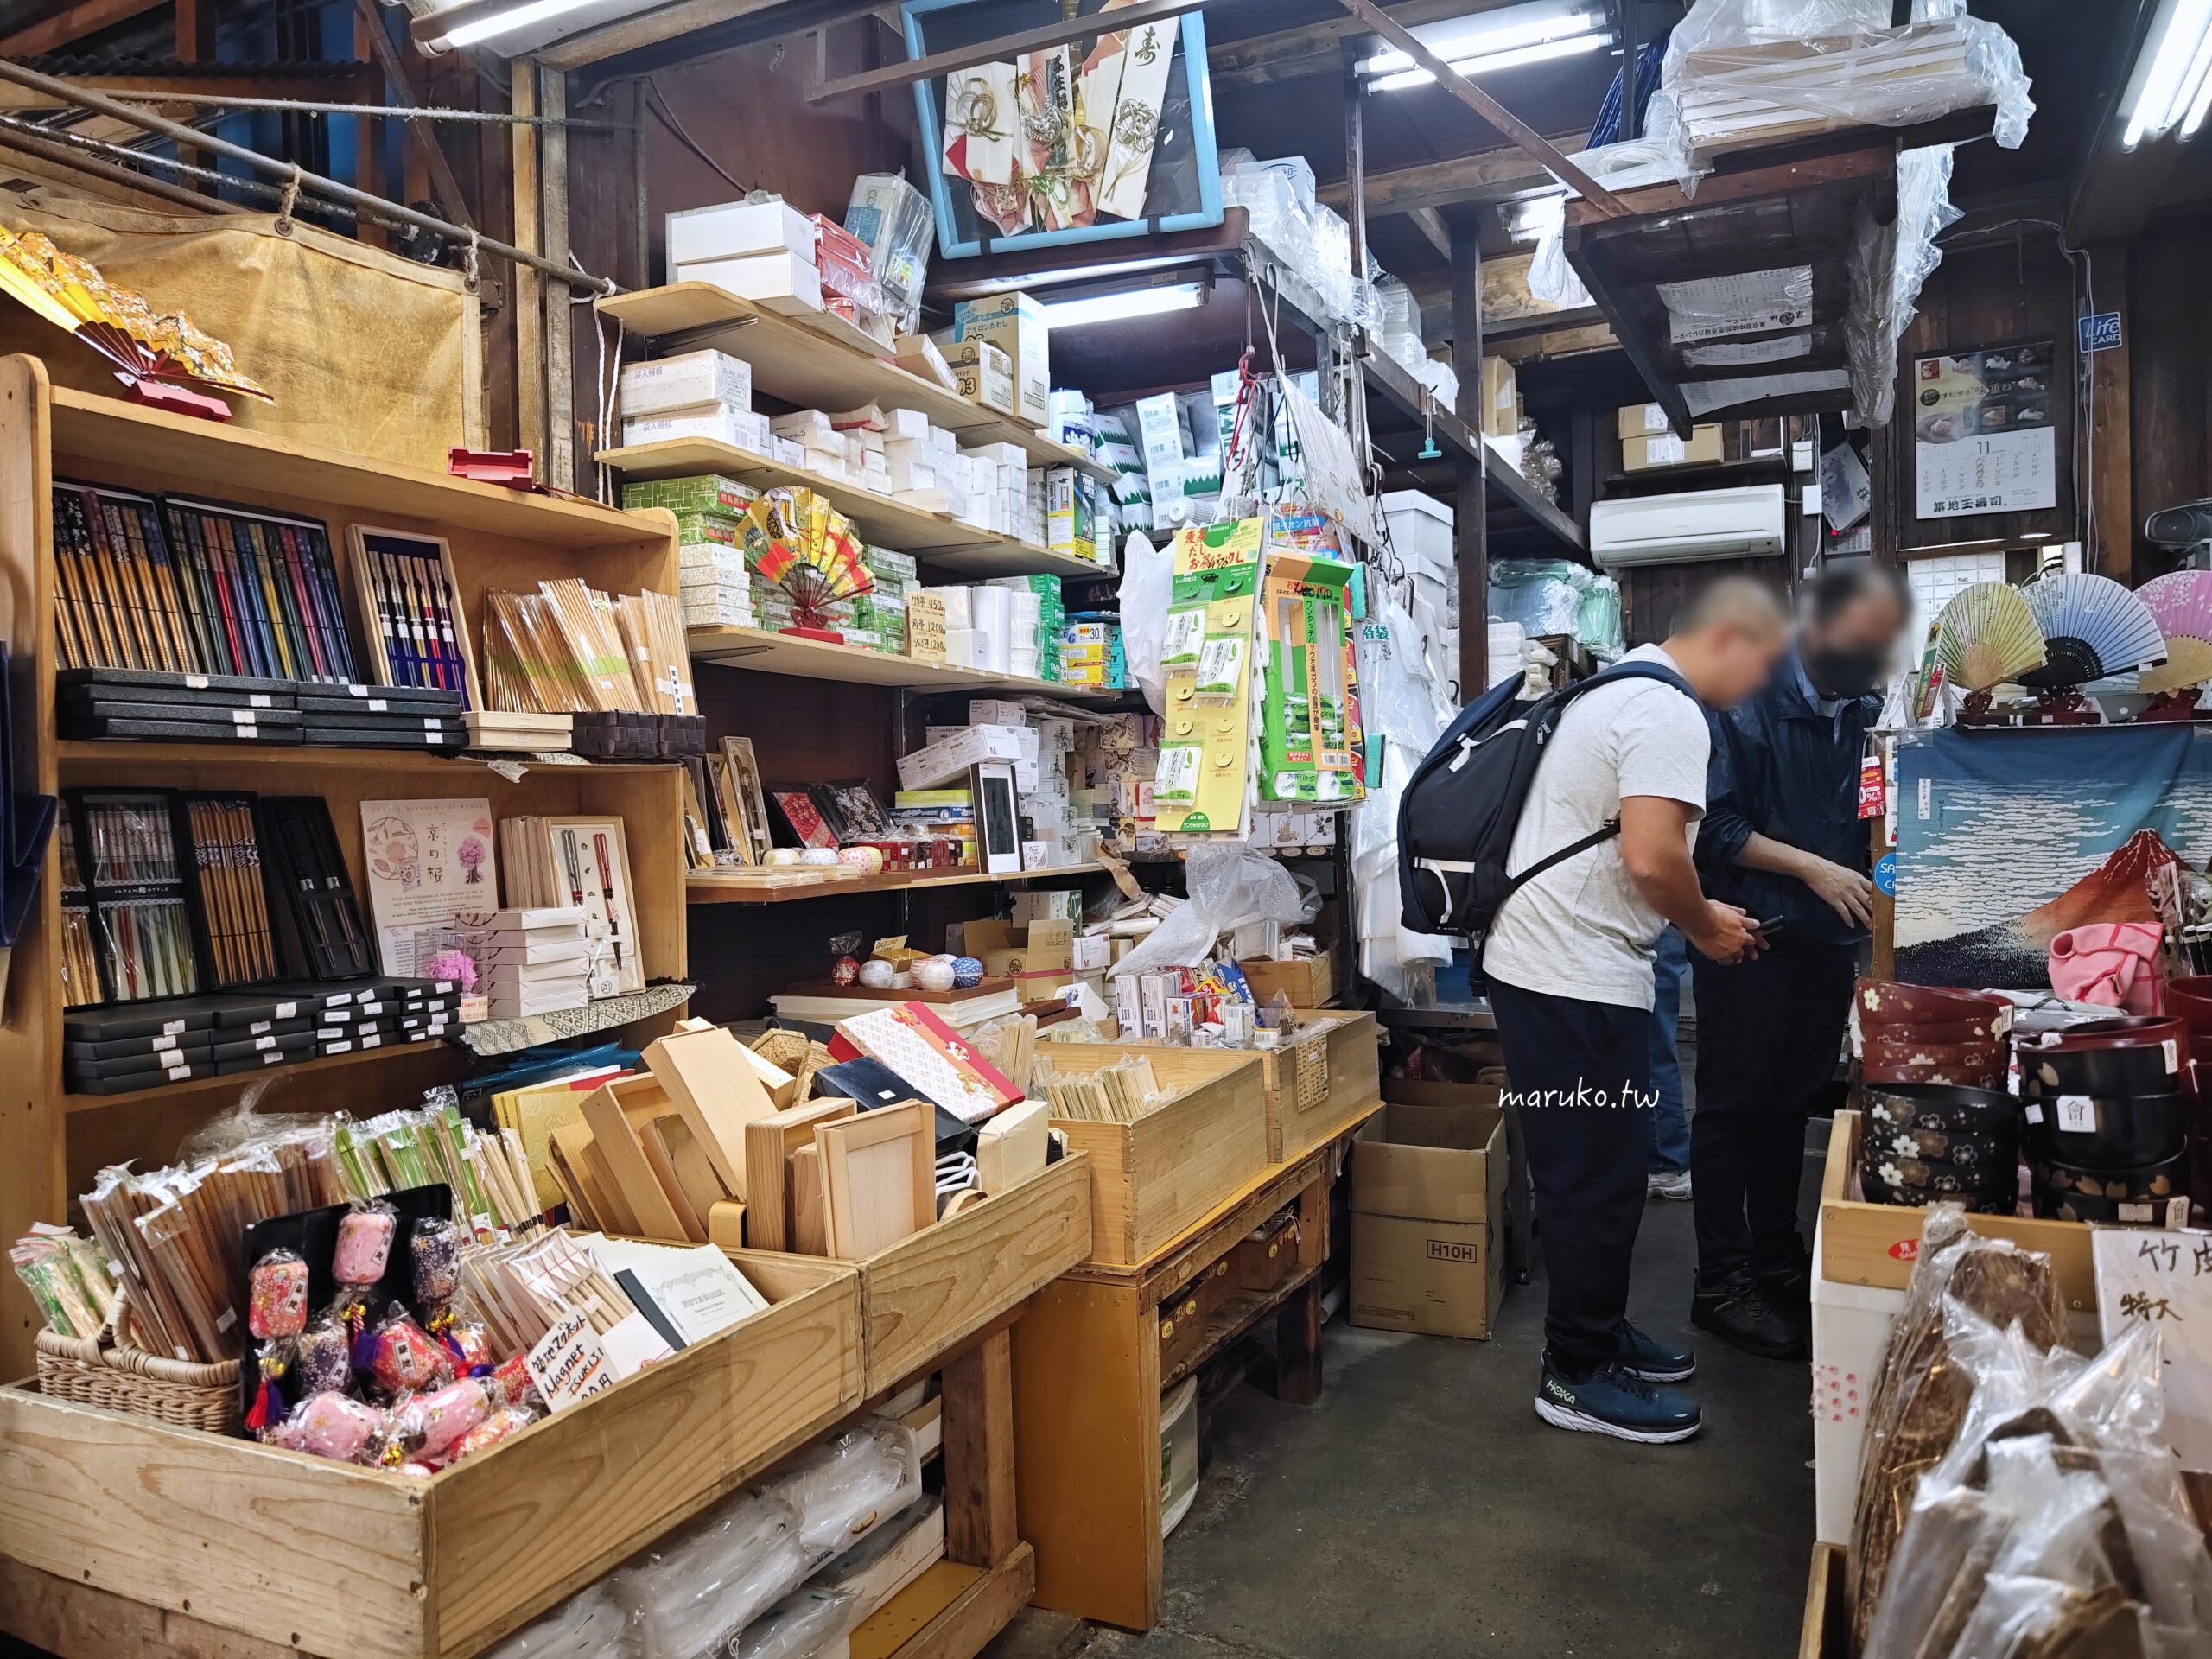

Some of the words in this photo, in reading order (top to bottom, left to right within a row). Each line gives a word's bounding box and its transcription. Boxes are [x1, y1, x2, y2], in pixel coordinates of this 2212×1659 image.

[1135, 25, 1160, 67] 寿
[965, 320, 1008, 333] ナイロンたわし
[2086, 318, 2120, 338] Life
[2091, 334, 2120, 345] CARD
[634, 366, 663, 380] 袋入楊枝
[643, 420, 672, 433] 袋入楊枝
[1977, 441, 1990, 454] 11
[1933, 495, 2002, 512] 築地玉壽司
[990, 747, 997, 755] M
[1431, 1243, 1472, 1260] H10H
[2120, 1291, 2183, 1321] 特大
[531, 1315, 587, 1374] 築地マグネット
[543, 1343, 584, 1399] Magnet
[1546, 1379, 1575, 1405] HOKA
